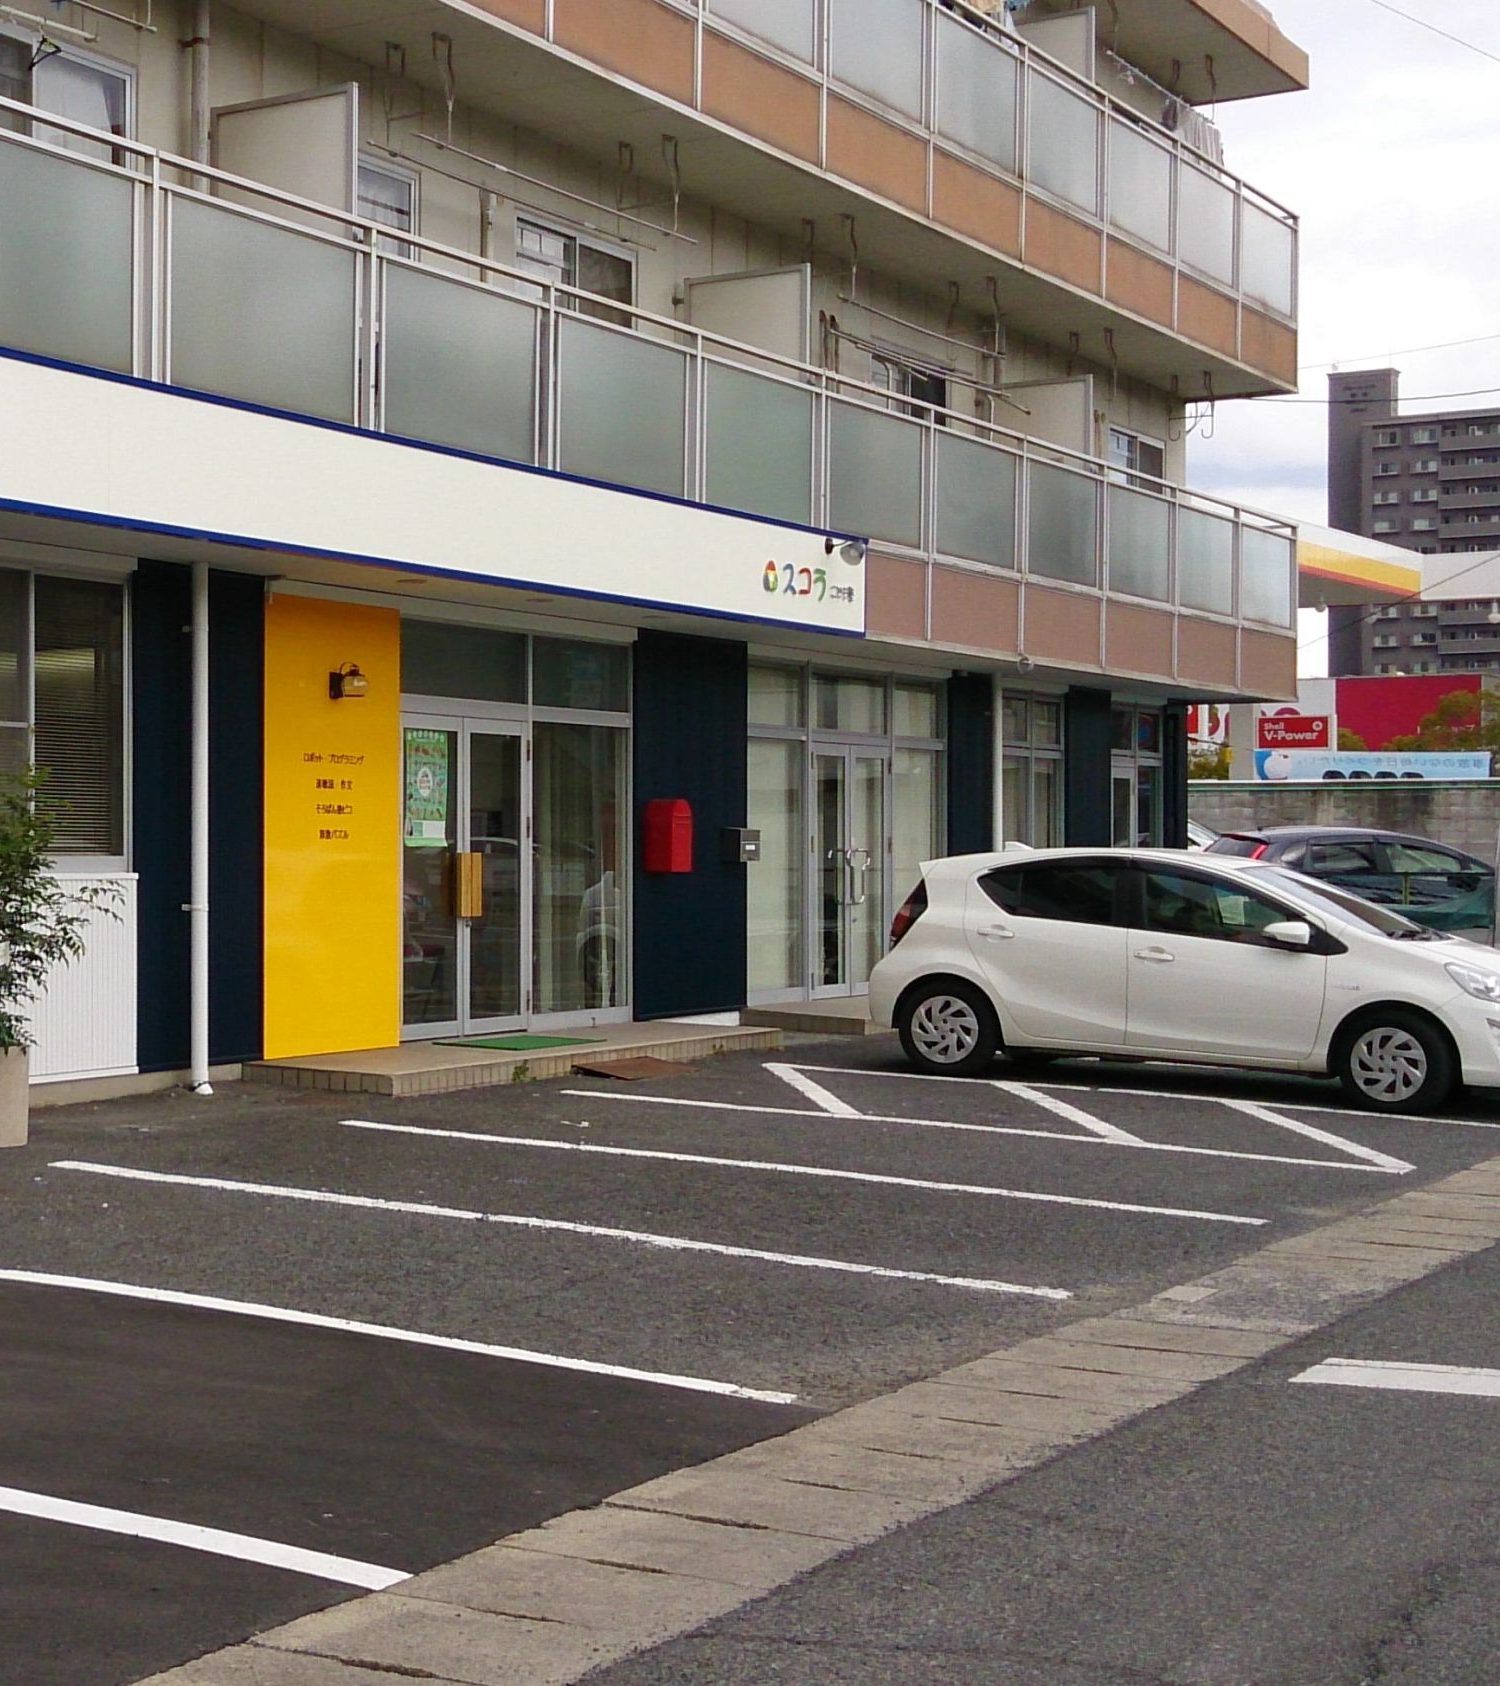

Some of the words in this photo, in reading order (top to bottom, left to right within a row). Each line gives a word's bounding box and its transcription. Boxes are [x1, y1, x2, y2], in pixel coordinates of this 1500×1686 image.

[782, 563, 827, 603] スコラ
[1264, 722, 1285, 730] Shell
[1264, 731, 1319, 741] V-Power
